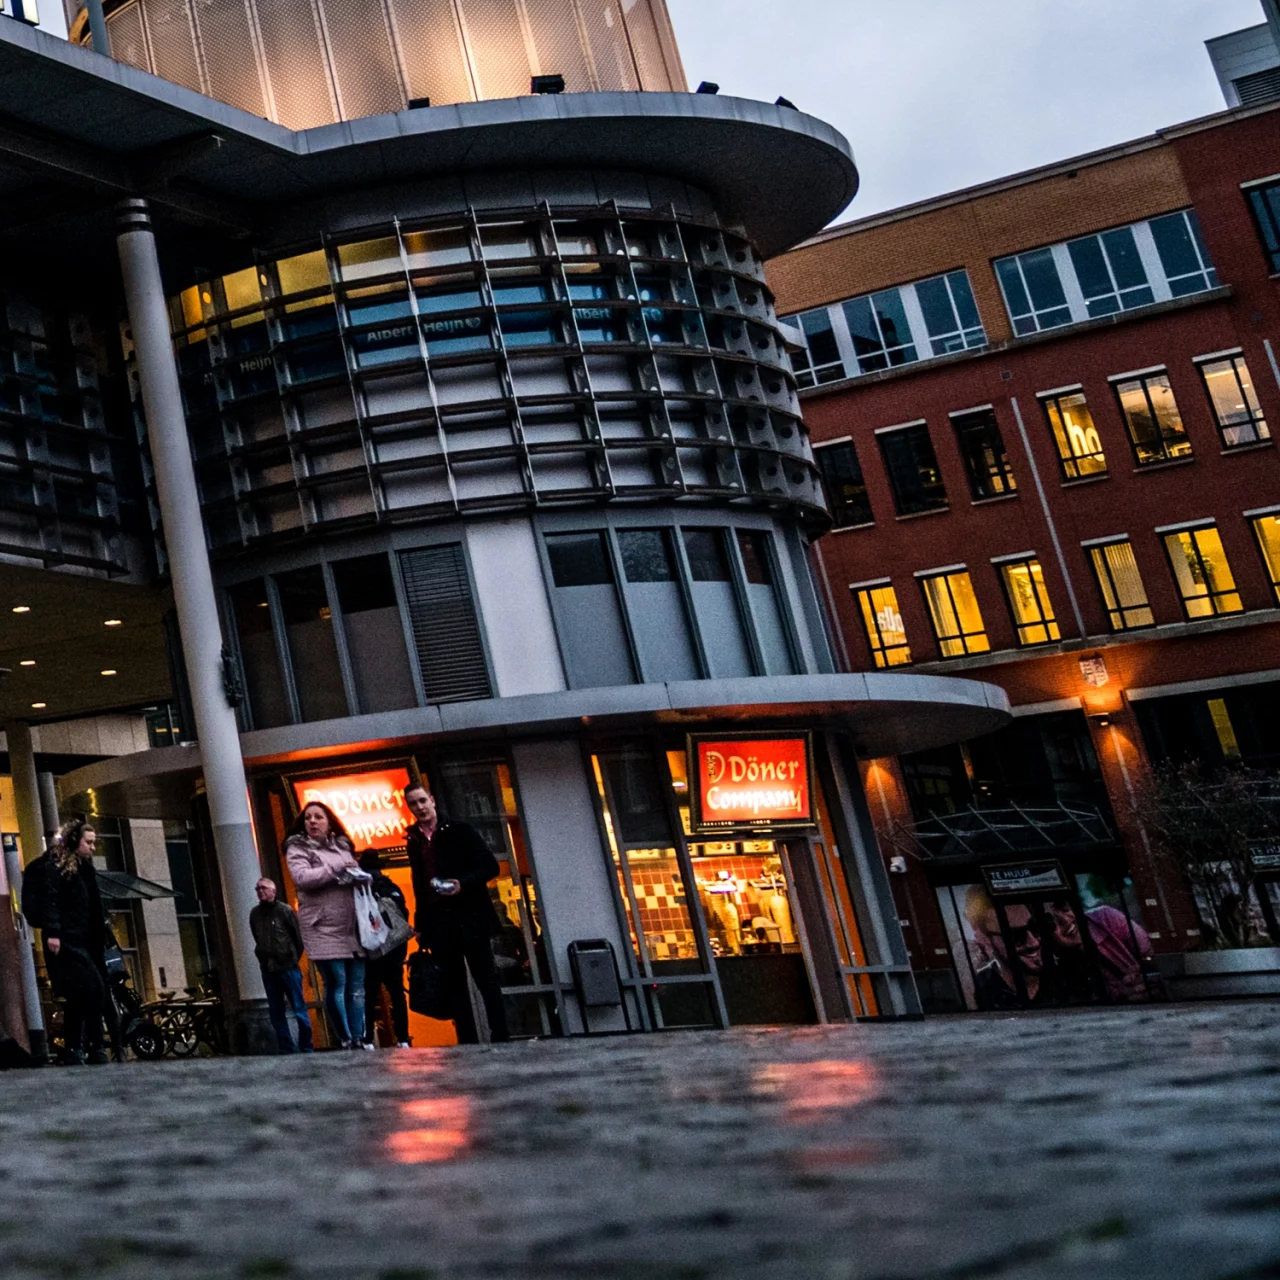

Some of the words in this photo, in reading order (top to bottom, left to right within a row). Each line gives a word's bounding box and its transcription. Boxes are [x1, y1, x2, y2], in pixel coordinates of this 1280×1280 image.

[727, 755, 800, 782] Döner
[327, 787, 406, 817] Döner
[706, 786, 802, 814] Company
[991, 871, 1002, 880] TE
[1003, 868, 1032, 879] HUUR
